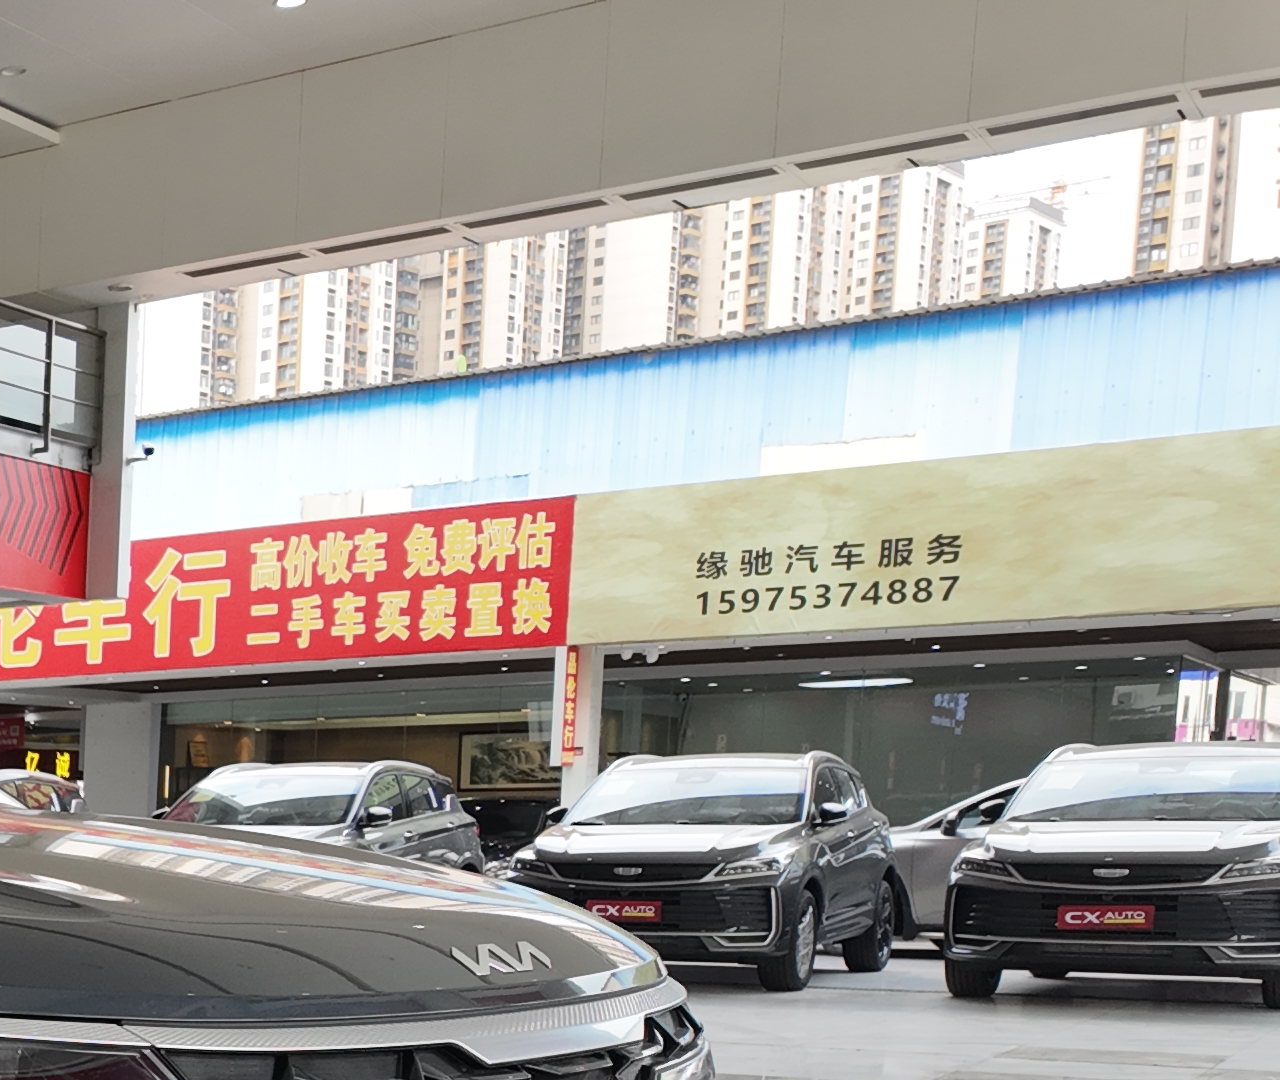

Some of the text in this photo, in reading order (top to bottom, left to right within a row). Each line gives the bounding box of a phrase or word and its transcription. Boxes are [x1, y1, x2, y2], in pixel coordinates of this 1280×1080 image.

[249, 511, 556, 592] 高价收车 免费评估
[696, 533, 963, 580] 缘驰汽车服务
[246, 577, 553, 650] 二手车买卖置换
[696, 575, 960, 616] 15975374887
[591, 904, 656, 918] CX AUTO
[1064, 911, 1146, 924] CX AUTO
